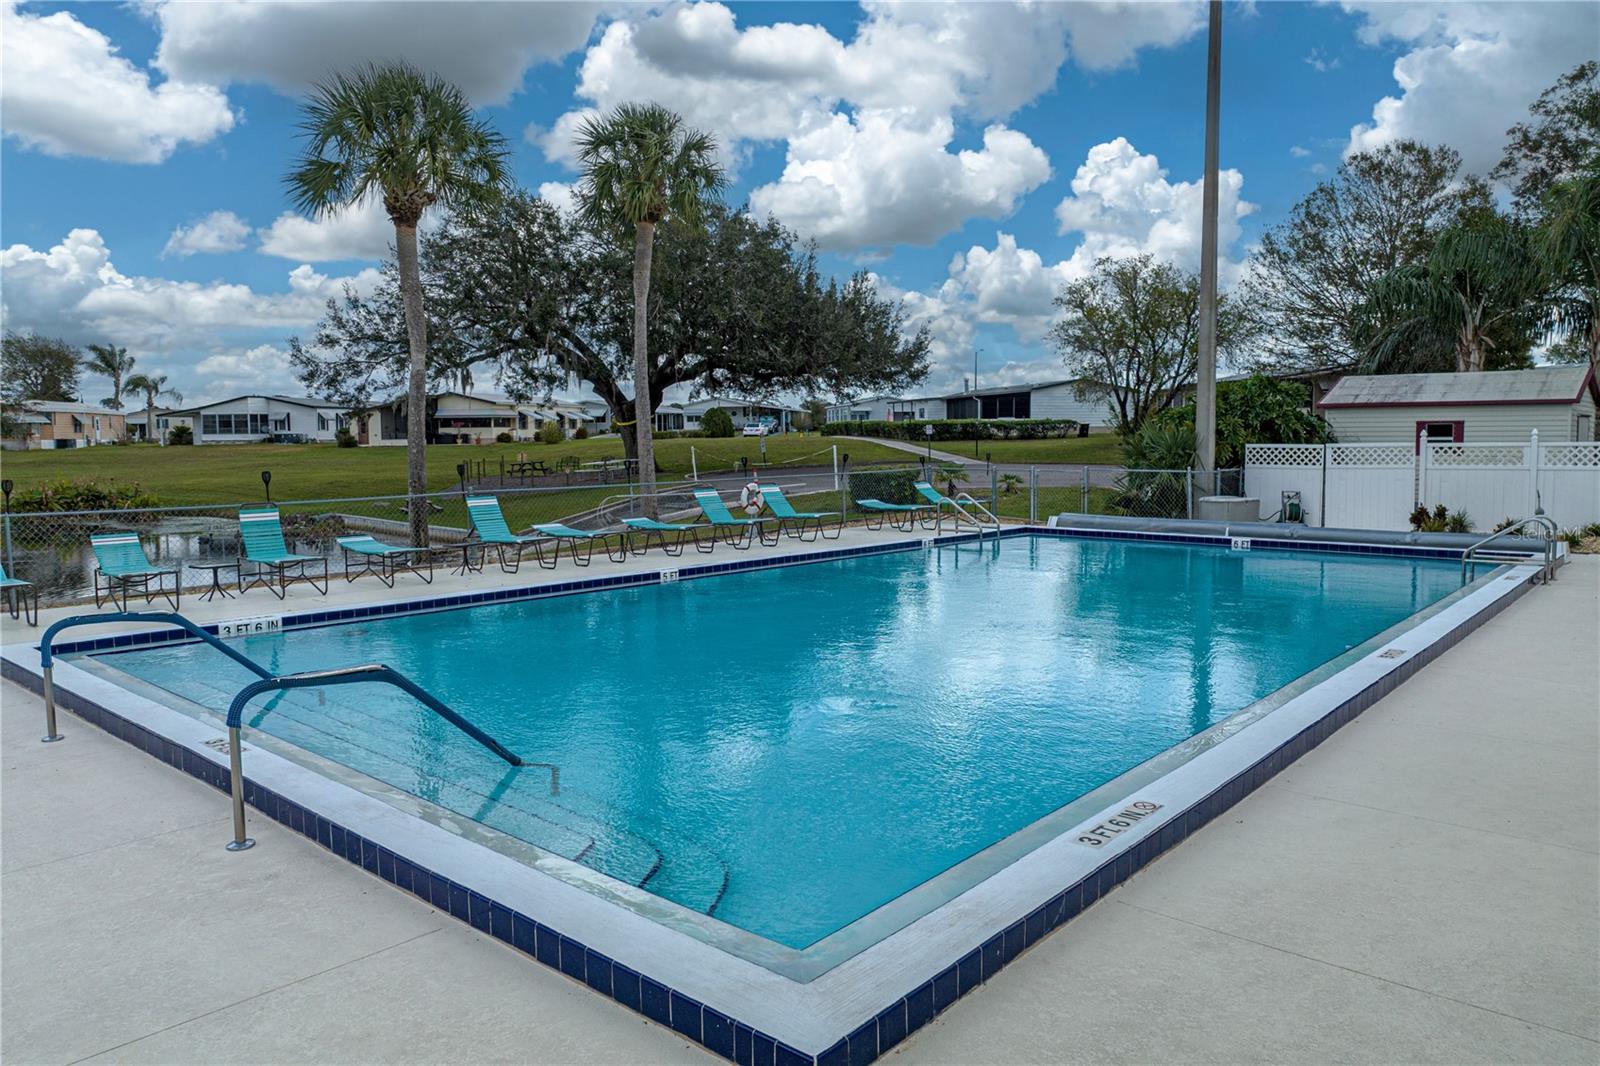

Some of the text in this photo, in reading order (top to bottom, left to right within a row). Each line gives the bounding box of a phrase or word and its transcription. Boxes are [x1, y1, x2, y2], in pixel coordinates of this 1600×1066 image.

[670, 571, 678, 579] FT
[223, 619, 279, 635] 3 FT 6 IN
[1078, 836, 1103, 846] 3
[1108, 819, 1131, 827] 6
